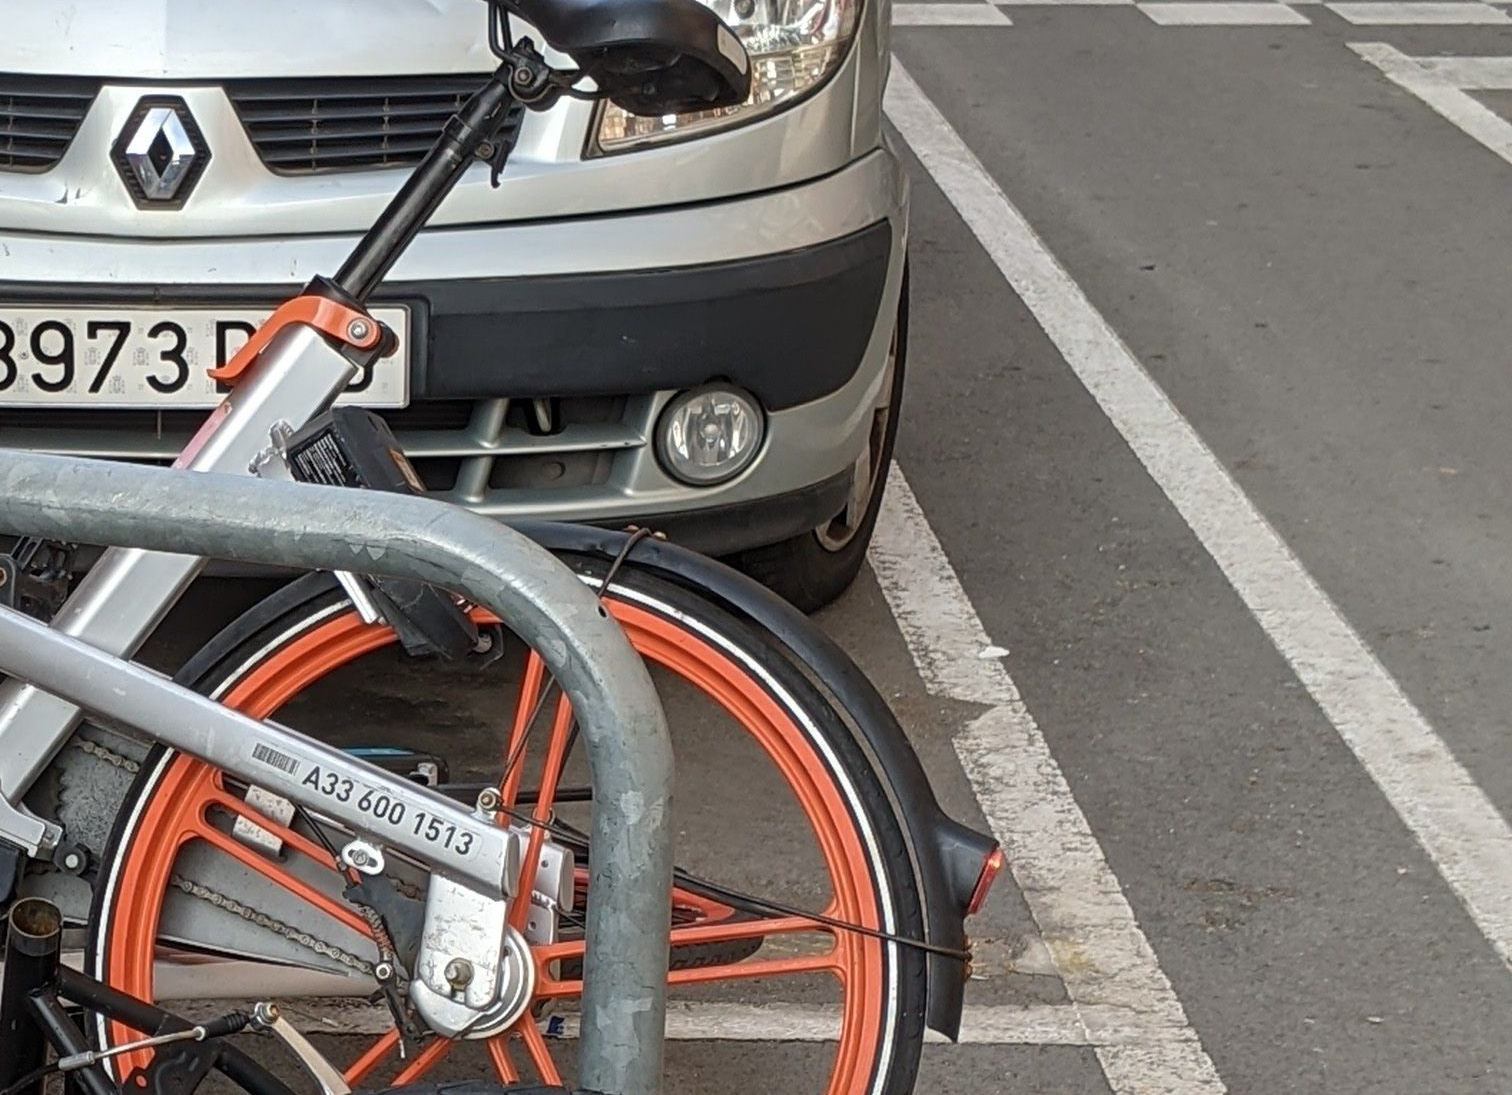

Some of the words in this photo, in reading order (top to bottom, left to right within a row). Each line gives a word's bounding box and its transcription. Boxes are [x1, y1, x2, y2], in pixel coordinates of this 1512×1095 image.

[301, 766, 355, 802] A33
[357, 789, 406, 826] 600
[411, 812, 474, 856] 1513
